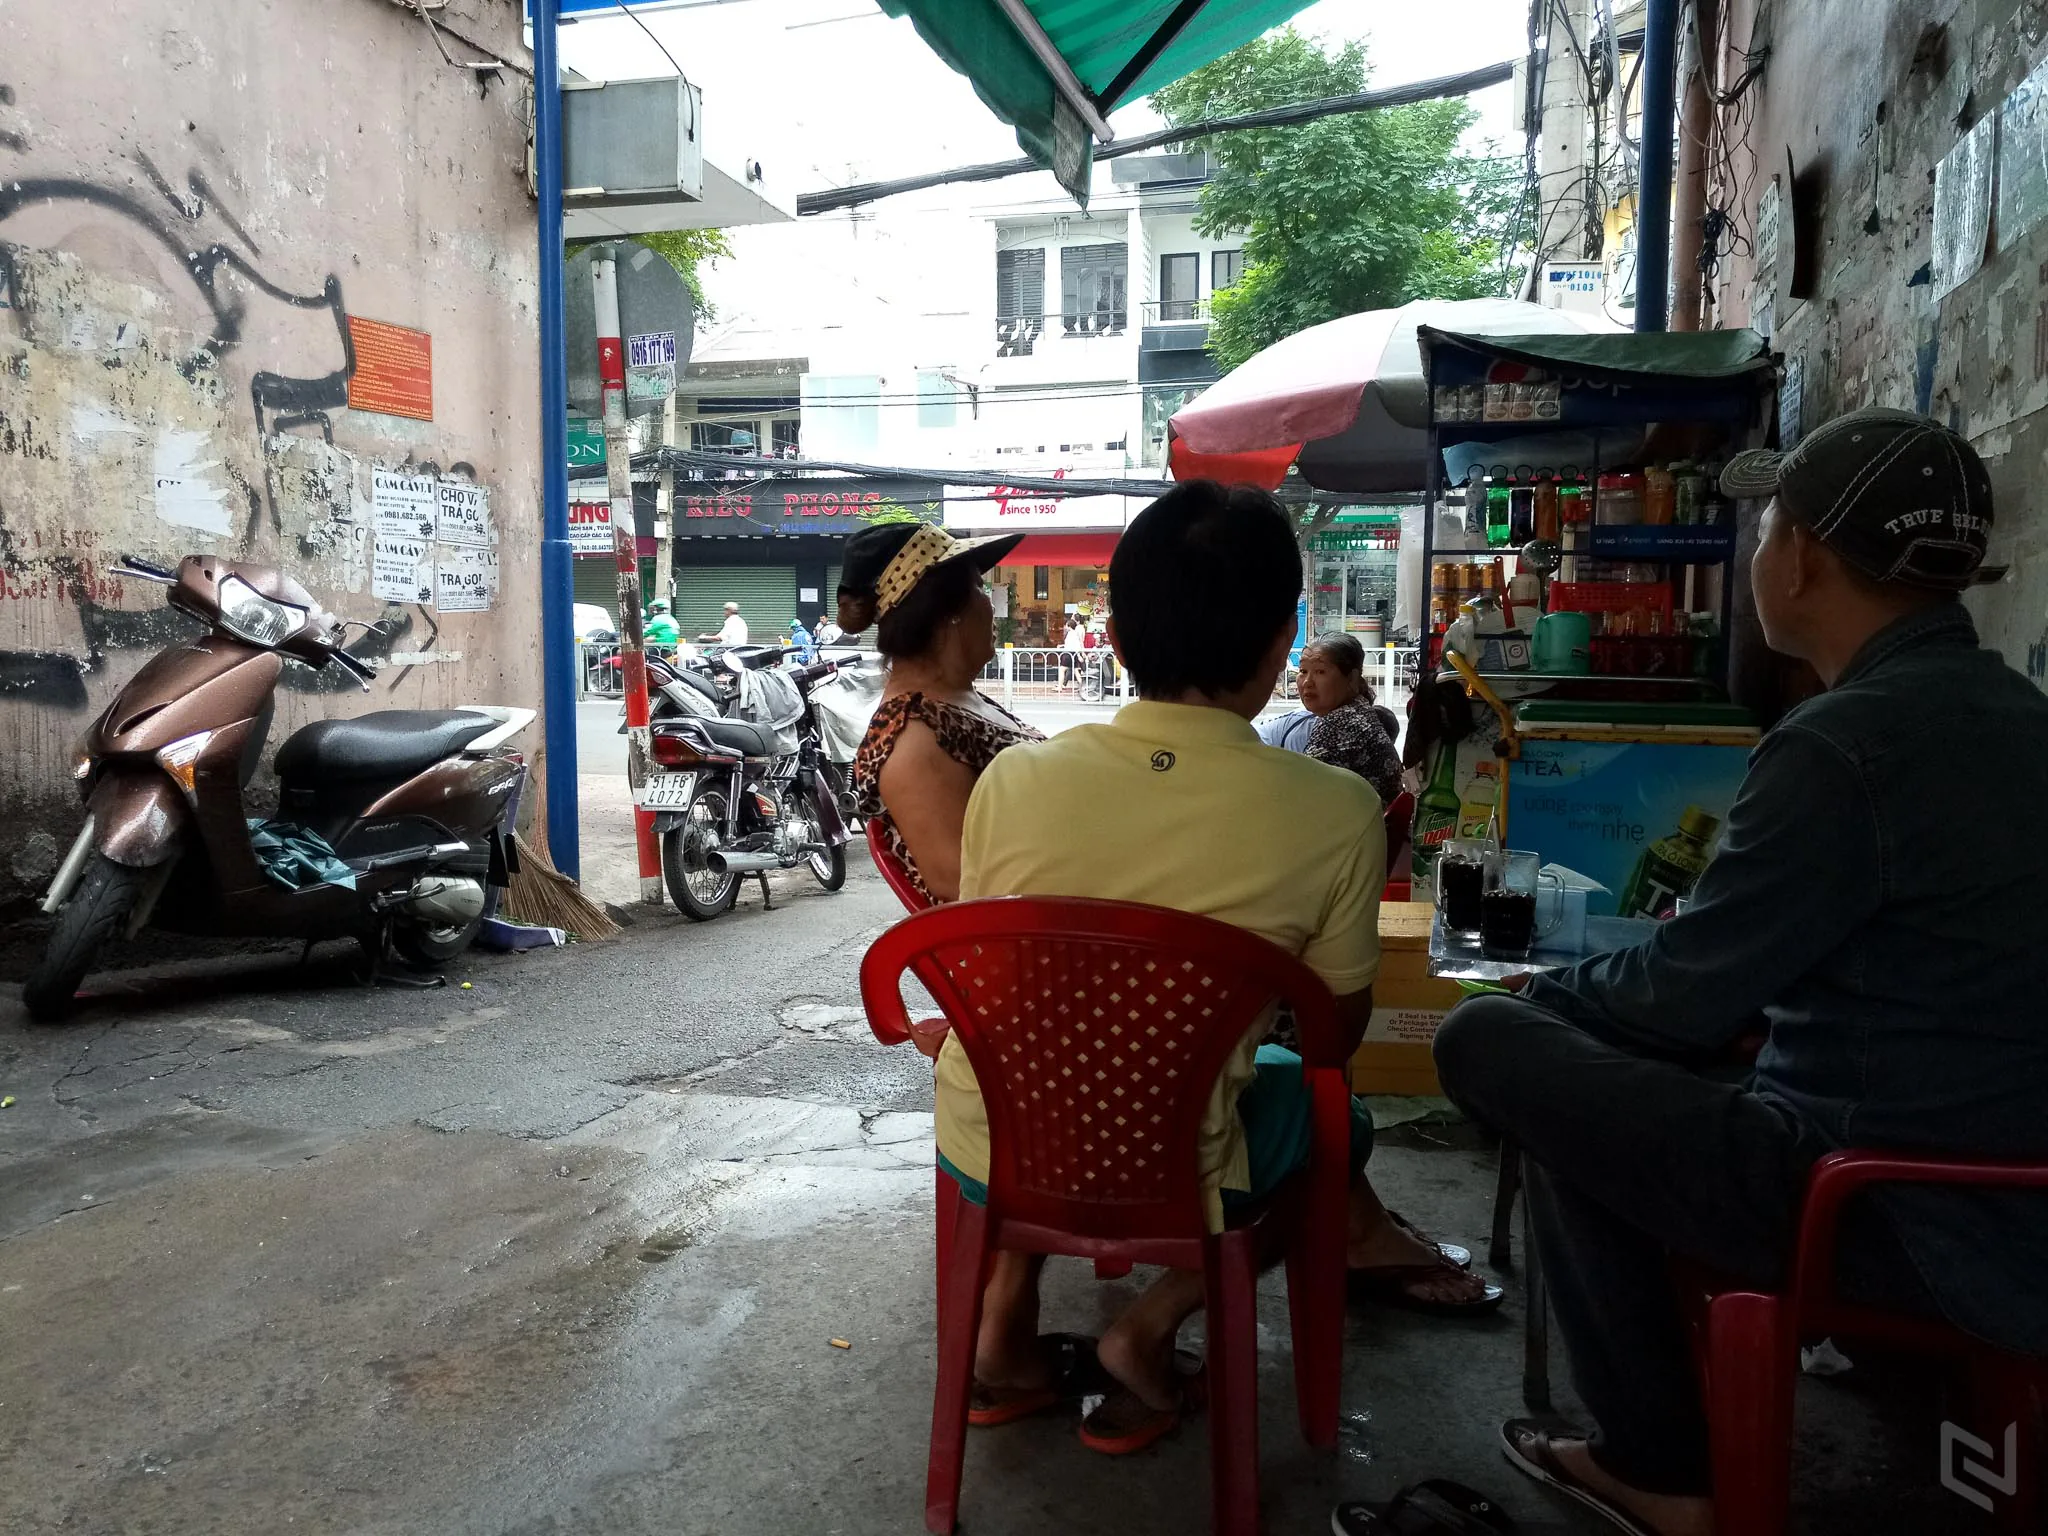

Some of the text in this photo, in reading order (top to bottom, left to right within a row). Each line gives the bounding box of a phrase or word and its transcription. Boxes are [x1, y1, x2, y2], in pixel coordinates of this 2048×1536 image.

[1570, 283, 1594, 291] 0103
[1006, 504, 1057, 514] since 1950
[1884, 509, 1944, 534] TRUE
[1522, 760, 1563, 776] TEA
[648, 790, 683, 804] 4072
[1602, 818, 1645, 845] nhẹ
